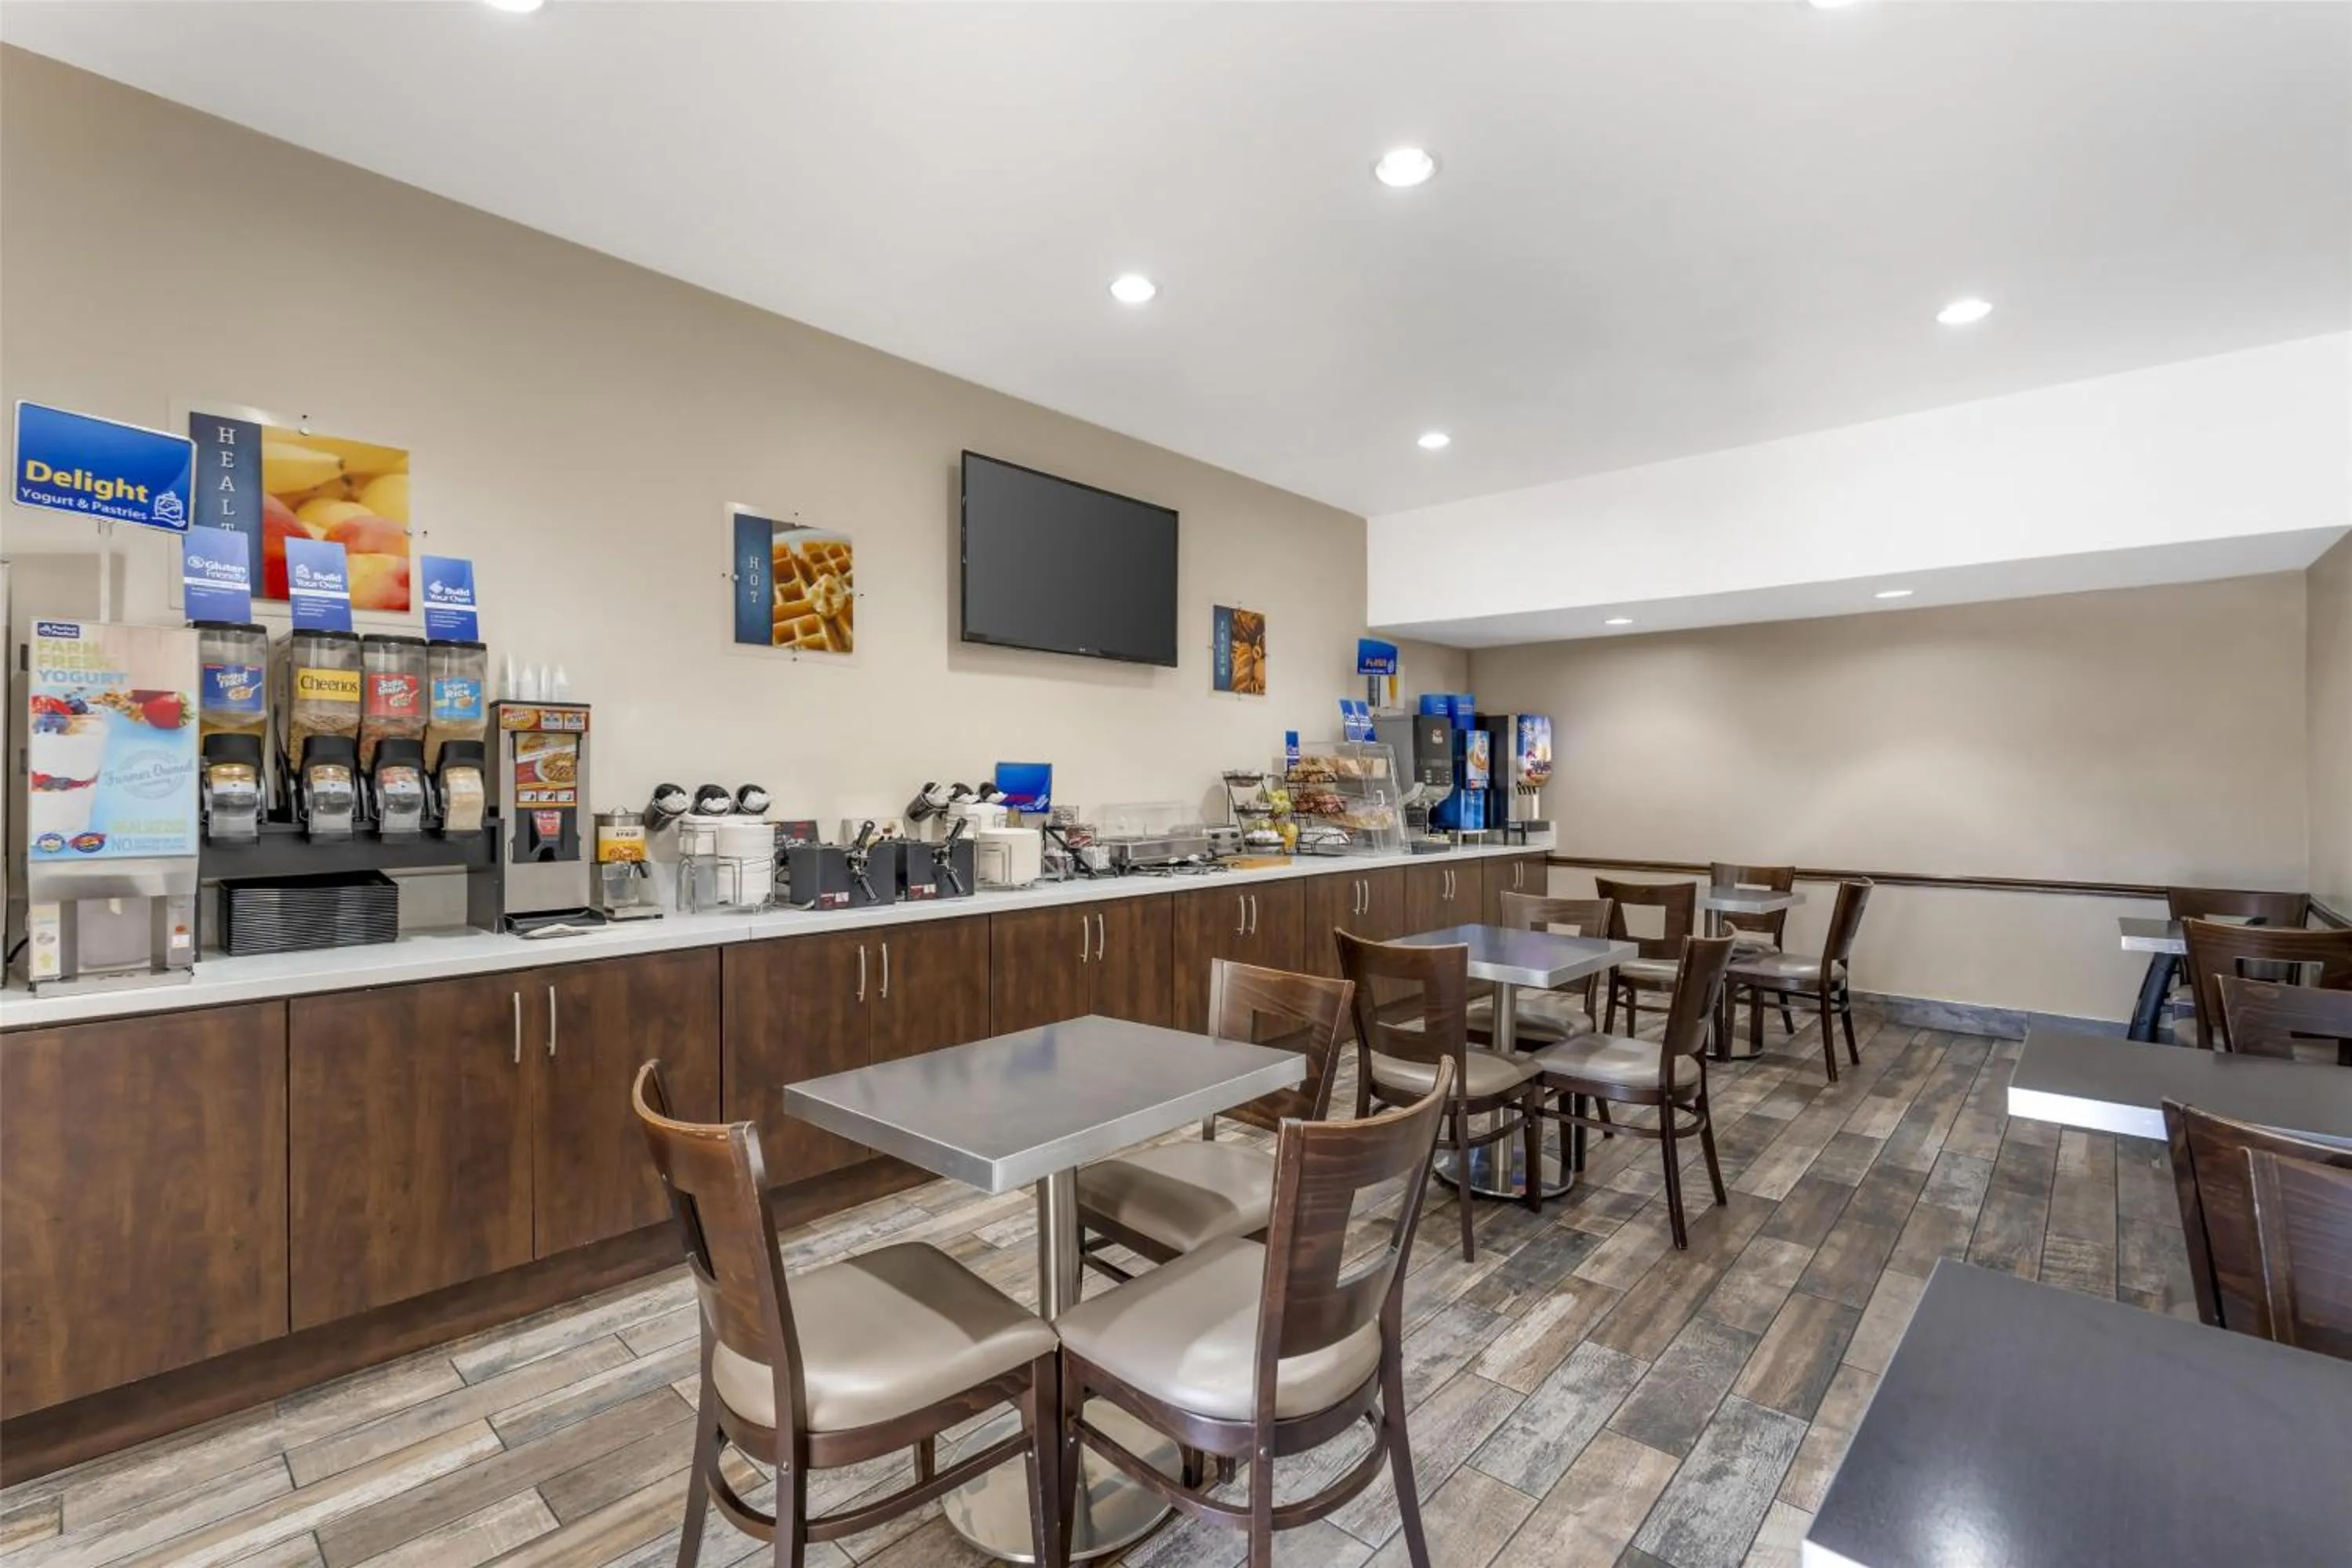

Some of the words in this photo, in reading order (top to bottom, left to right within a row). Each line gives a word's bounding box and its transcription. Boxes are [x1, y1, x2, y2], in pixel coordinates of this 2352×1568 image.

[26, 459, 149, 503] Delight
[20, 486, 74, 508] Yogurt
[78, 498, 89, 509] &
[91, 500, 148, 521] Pastries
[205, 561, 245, 574] Gluten
[314, 571, 342, 583] Build
[445, 587, 470, 597] Build
[38, 639, 102, 654] FARM
[38, 670, 126, 684] YOGURT
[301, 674, 358, 693] Cheerios
